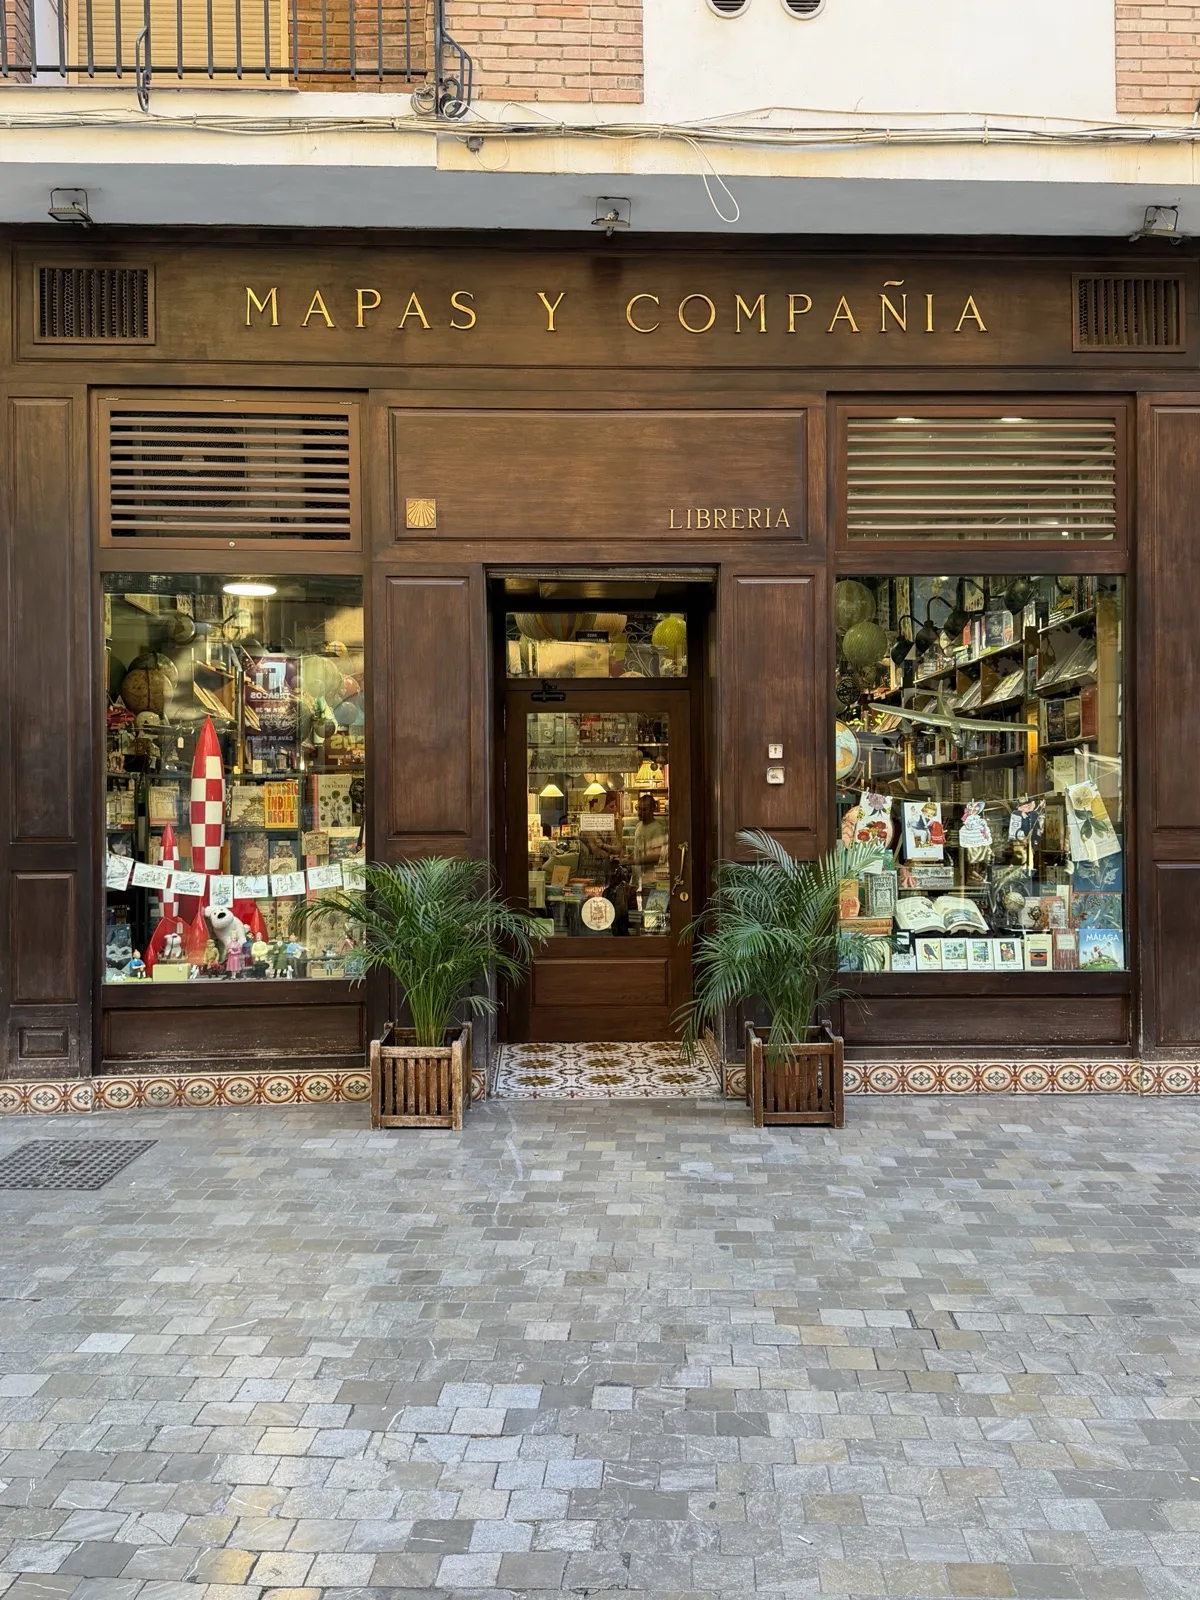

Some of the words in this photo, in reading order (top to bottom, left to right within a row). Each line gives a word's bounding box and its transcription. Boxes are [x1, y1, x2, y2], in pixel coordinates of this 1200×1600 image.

[244, 286, 478, 331] MAPAS
[536, 291, 567, 332] Y
[625, 279, 990, 334] COMPAÑIA
[668, 507, 791, 530] LIBRERIA
[1086, 932, 1120, 941] MÁLAGA
